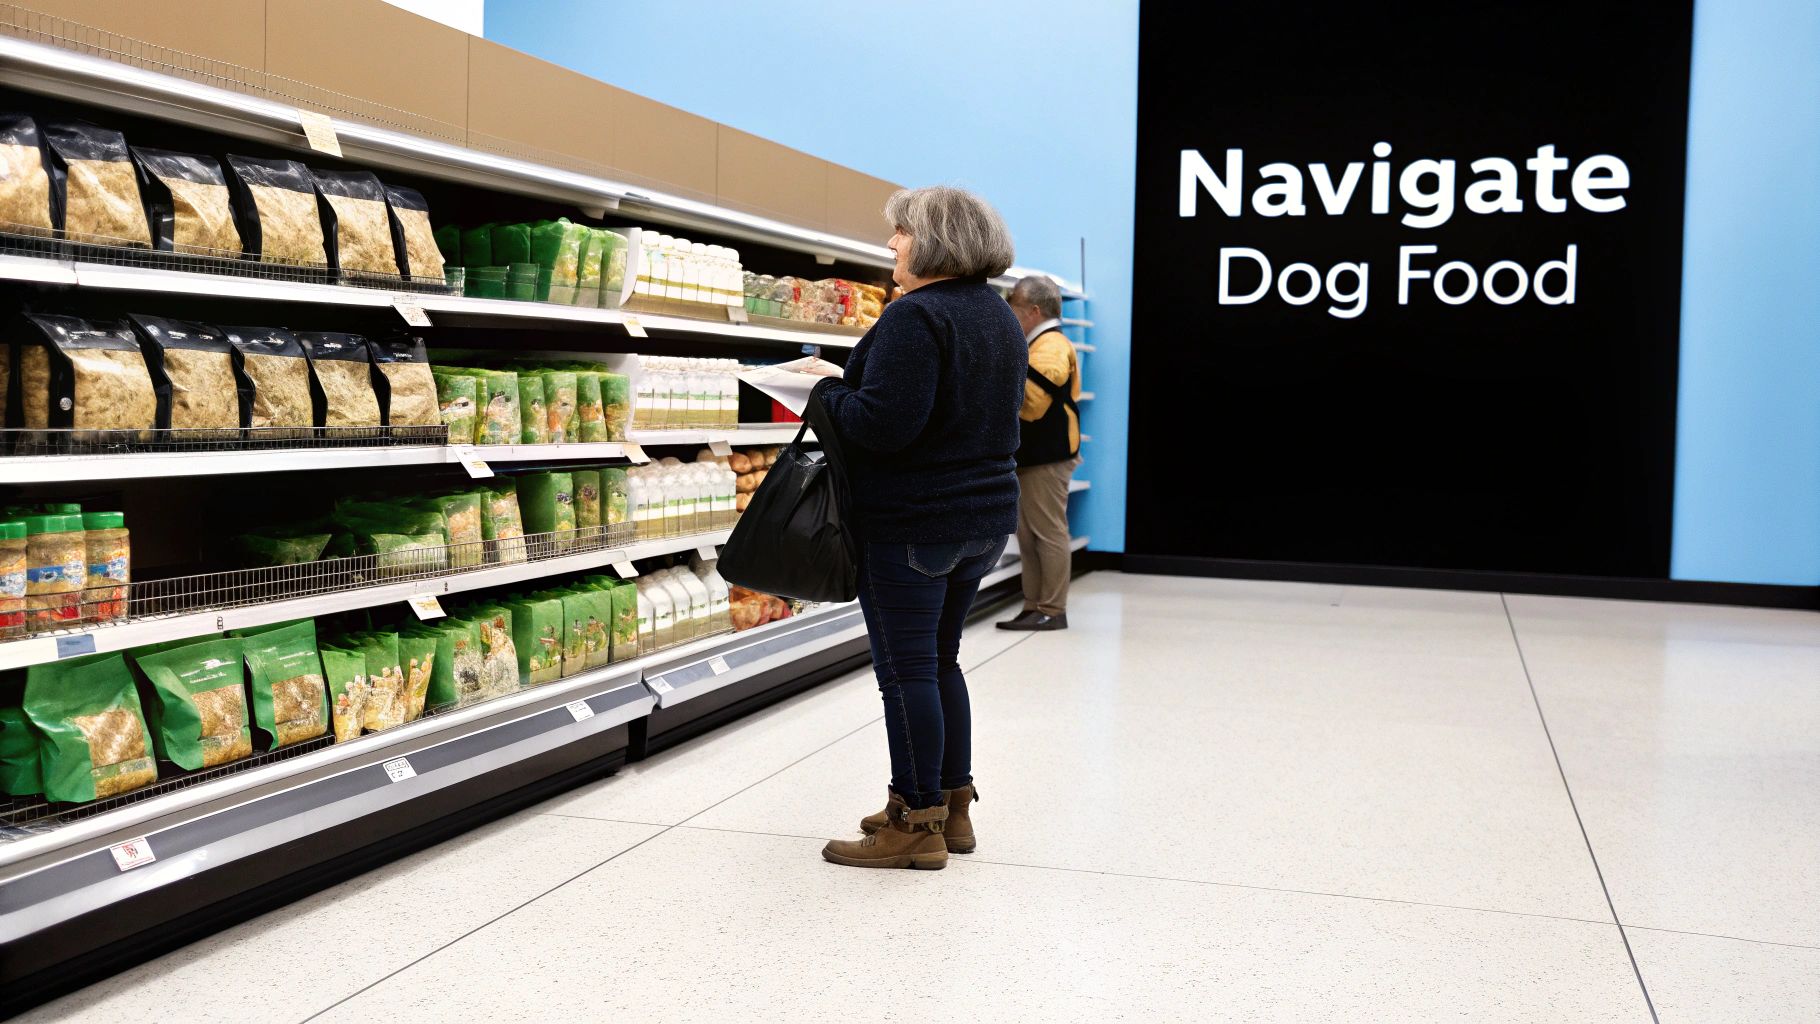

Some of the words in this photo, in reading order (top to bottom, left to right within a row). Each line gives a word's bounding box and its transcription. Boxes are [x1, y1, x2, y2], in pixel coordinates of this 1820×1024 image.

[1179, 141, 1630, 229] Navigate
[1218, 247, 1369, 319] Dog
[1398, 244, 1578, 306] Food
